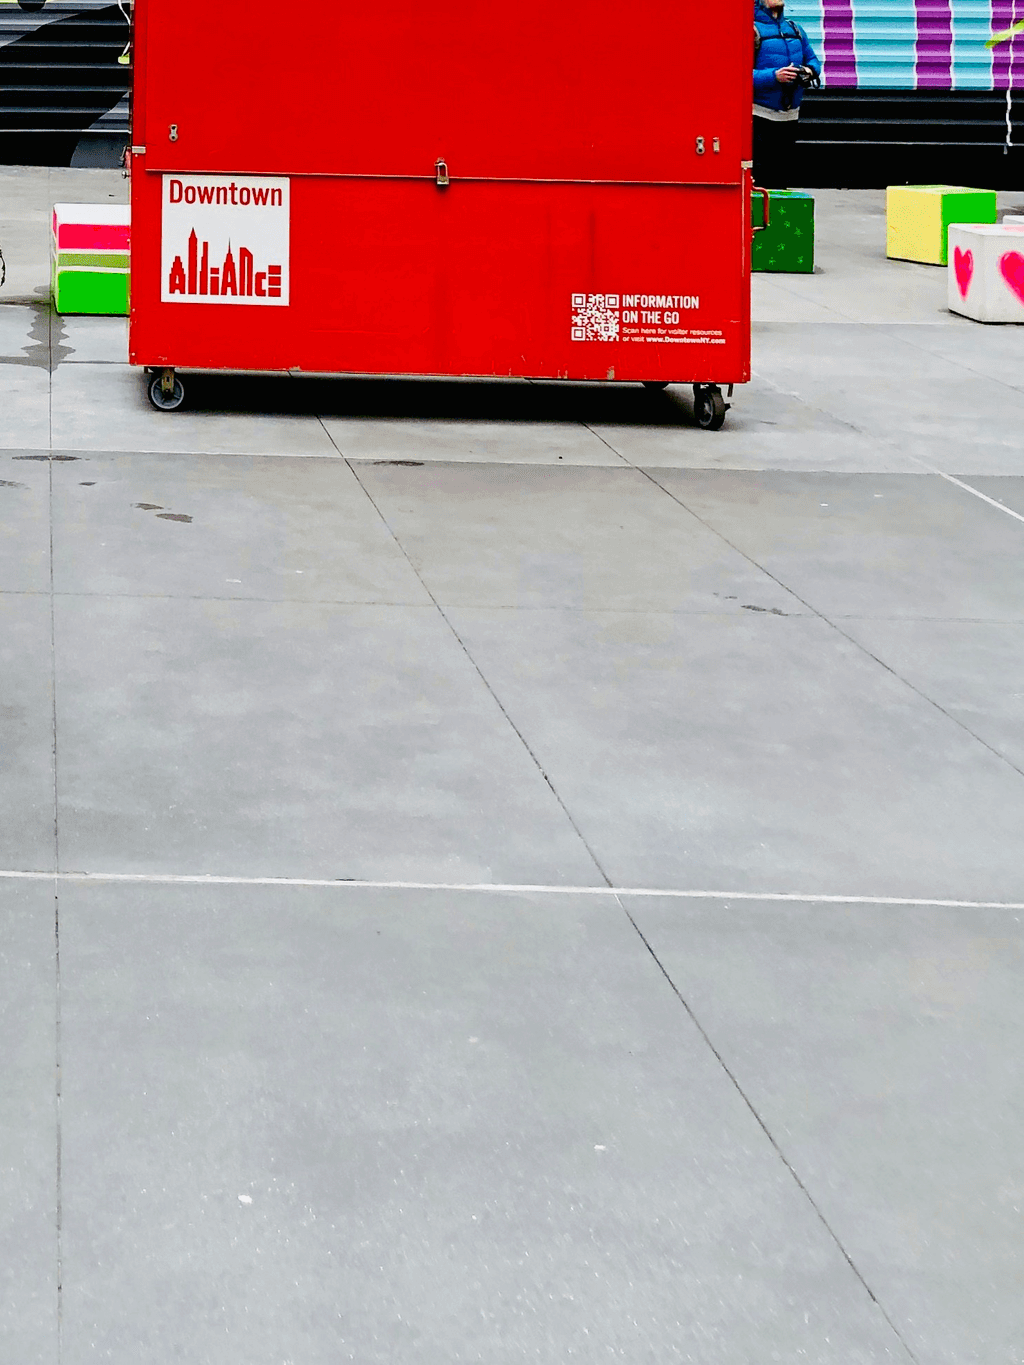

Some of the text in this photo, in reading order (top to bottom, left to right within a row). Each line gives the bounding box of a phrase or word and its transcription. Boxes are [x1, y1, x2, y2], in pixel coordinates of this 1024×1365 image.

[169, 179, 282, 206] Downtown
[622, 294, 700, 309] INFORMATION
[622, 310, 679, 325] ON THE GO
[622, 327, 639, 335] Scan
[640, 327, 656, 335] here
[657, 327, 667, 335] for
[668, 328, 688, 336] visitor
[646, 336, 726, 345] www.DowntownNY.com
